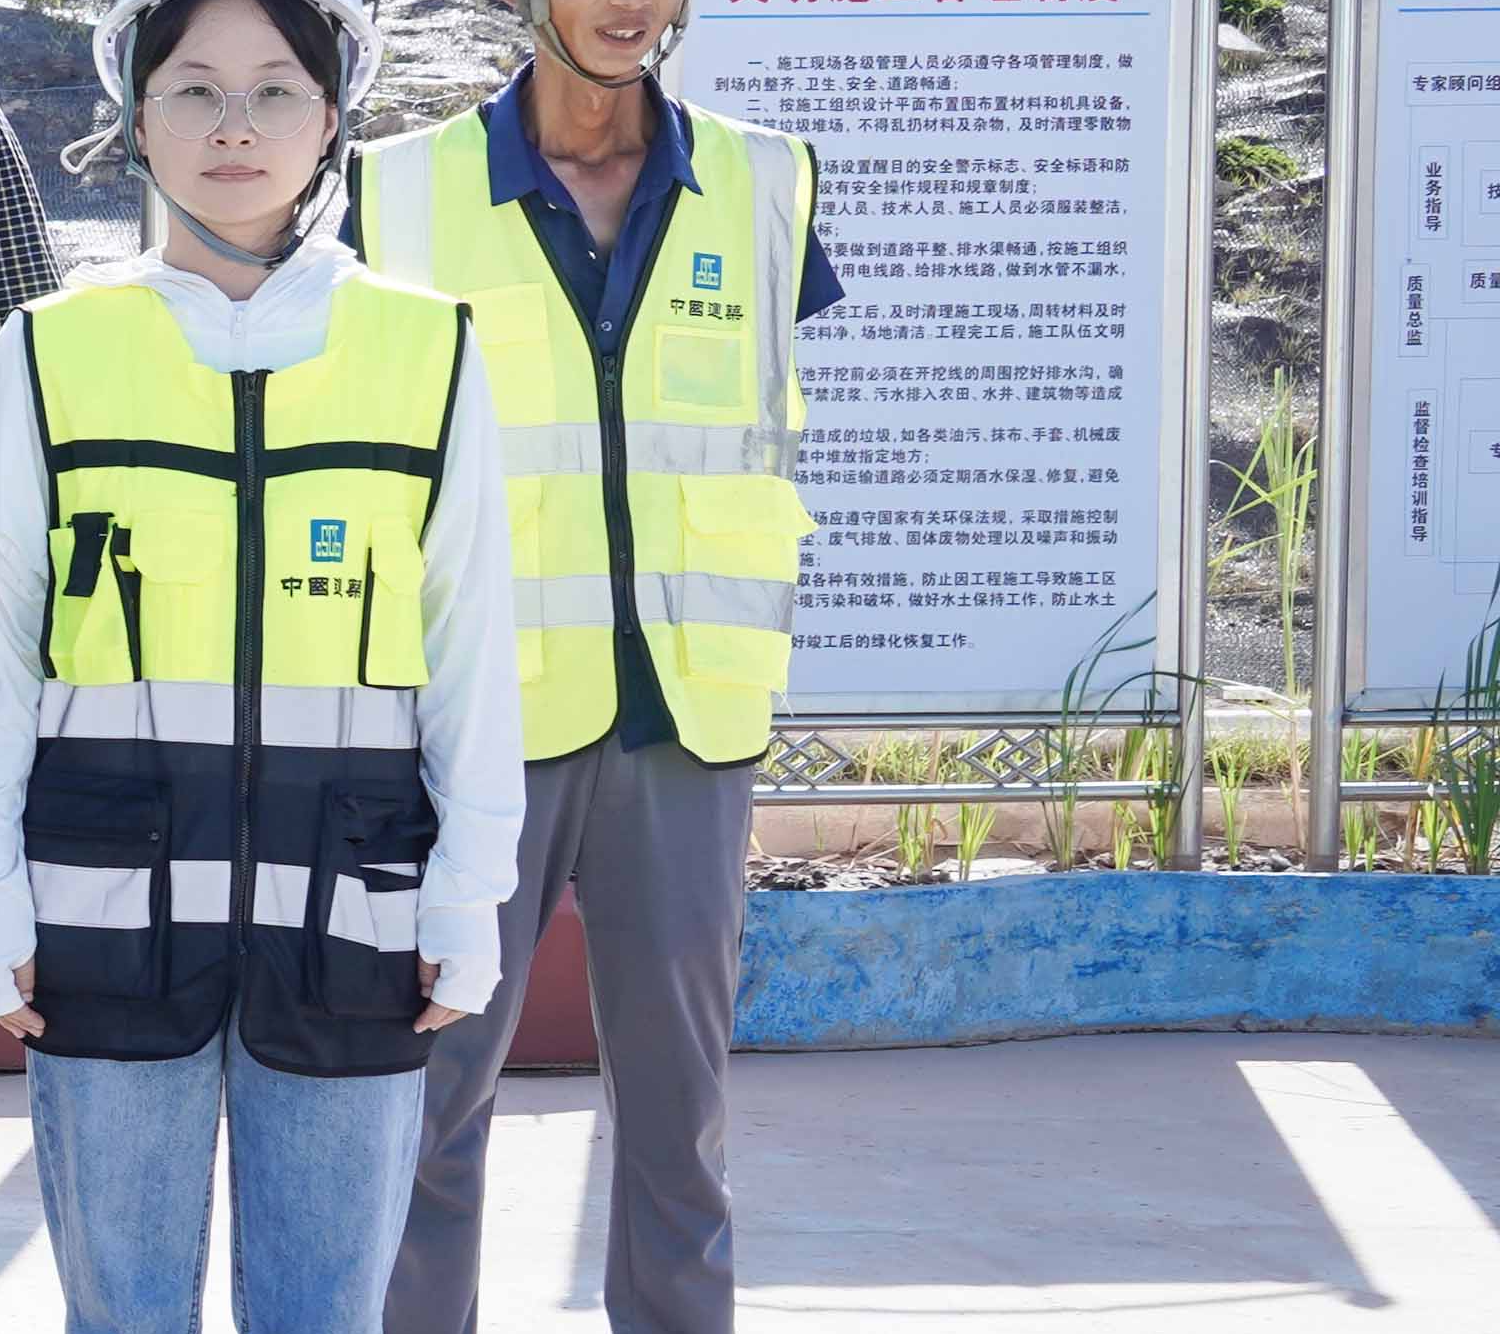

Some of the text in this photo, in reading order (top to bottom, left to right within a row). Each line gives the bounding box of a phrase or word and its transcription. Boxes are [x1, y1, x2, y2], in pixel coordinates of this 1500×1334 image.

[814, 199, 1129, 216] 理人员、技术人员、施工人员必须服装整洁,
[1424, 161, 1442, 233] 业务指导
[1405, 275, 1424, 346] 质量总监
[1411, 400, 1431, 544] 监督检查培训指导
[807, 509, 1119, 526] 场应遵守国家有关环保法规,采取措施控制
